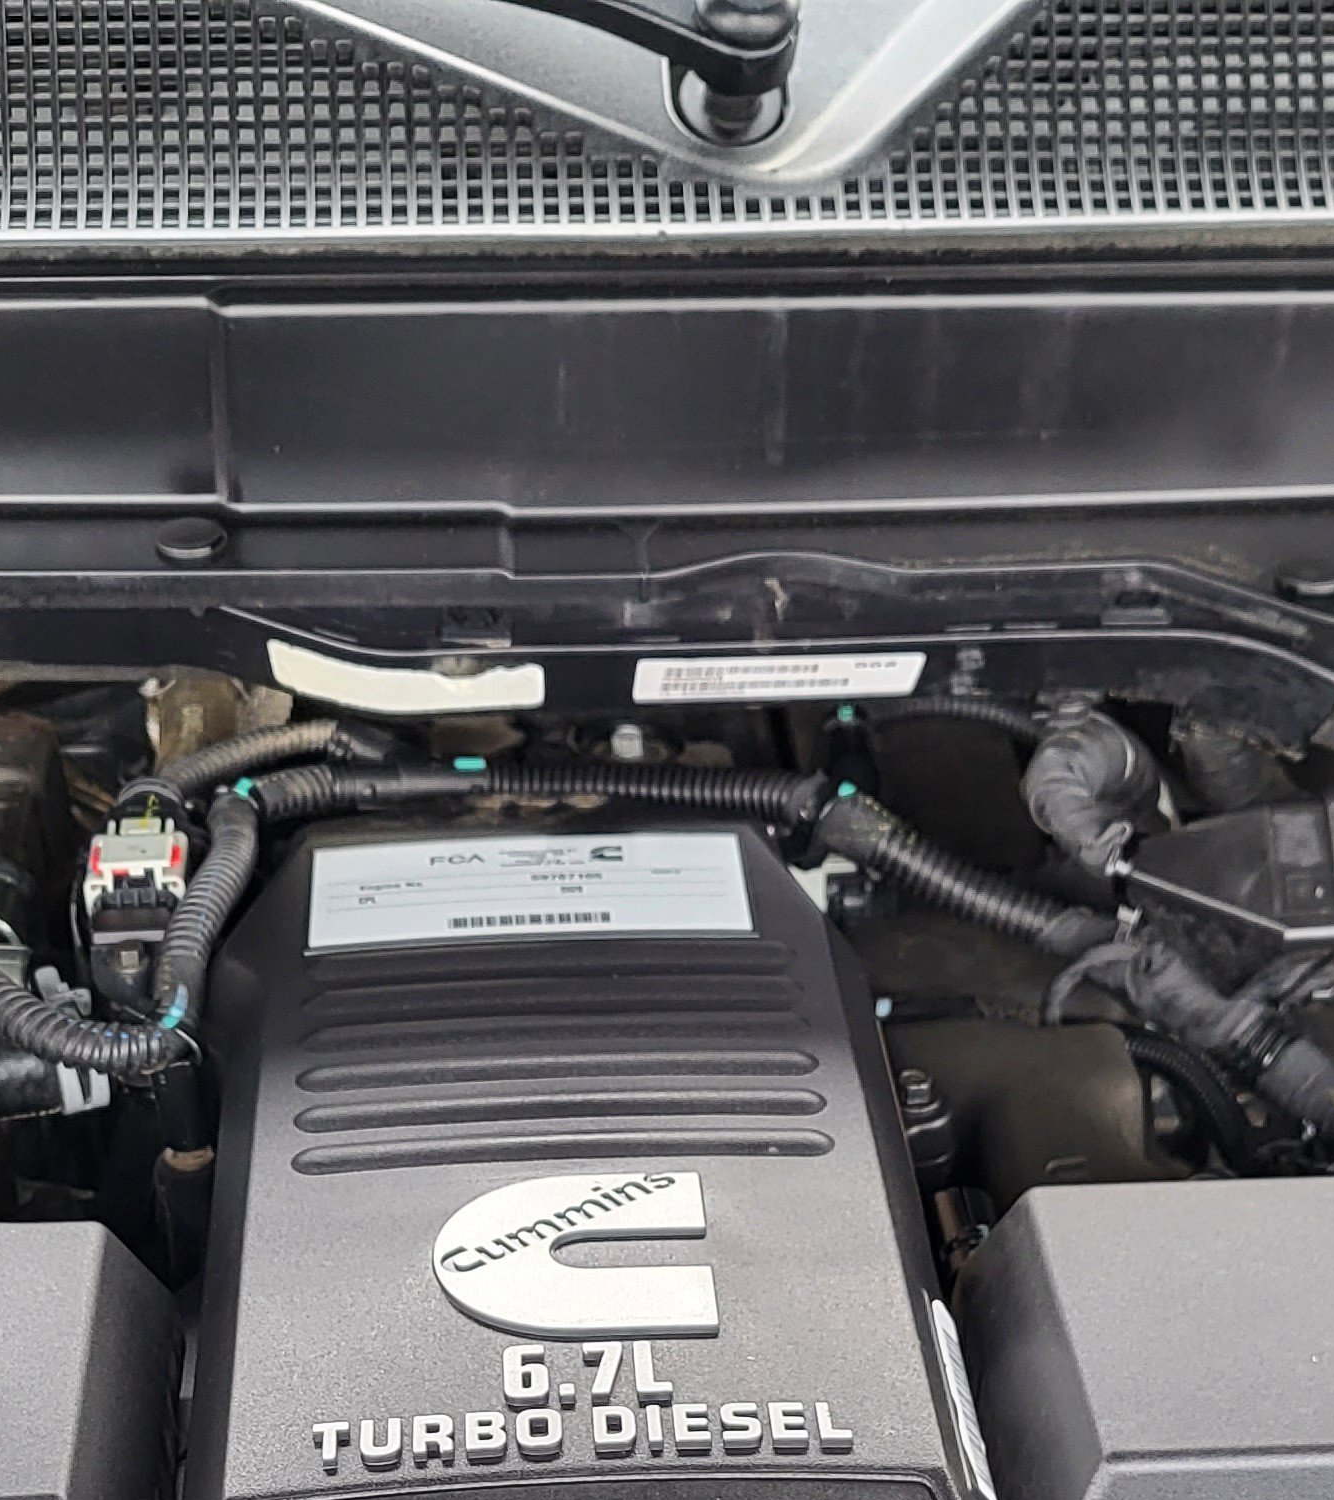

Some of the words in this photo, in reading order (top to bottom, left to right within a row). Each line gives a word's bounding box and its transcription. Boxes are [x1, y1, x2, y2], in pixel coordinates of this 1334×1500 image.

[439, 1171, 677, 1273] Cummins
[502, 1341, 674, 1407] 6.7L
[312, 1408, 563, 1474] TURBO
[592, 1402, 854, 1457] DIESEL
